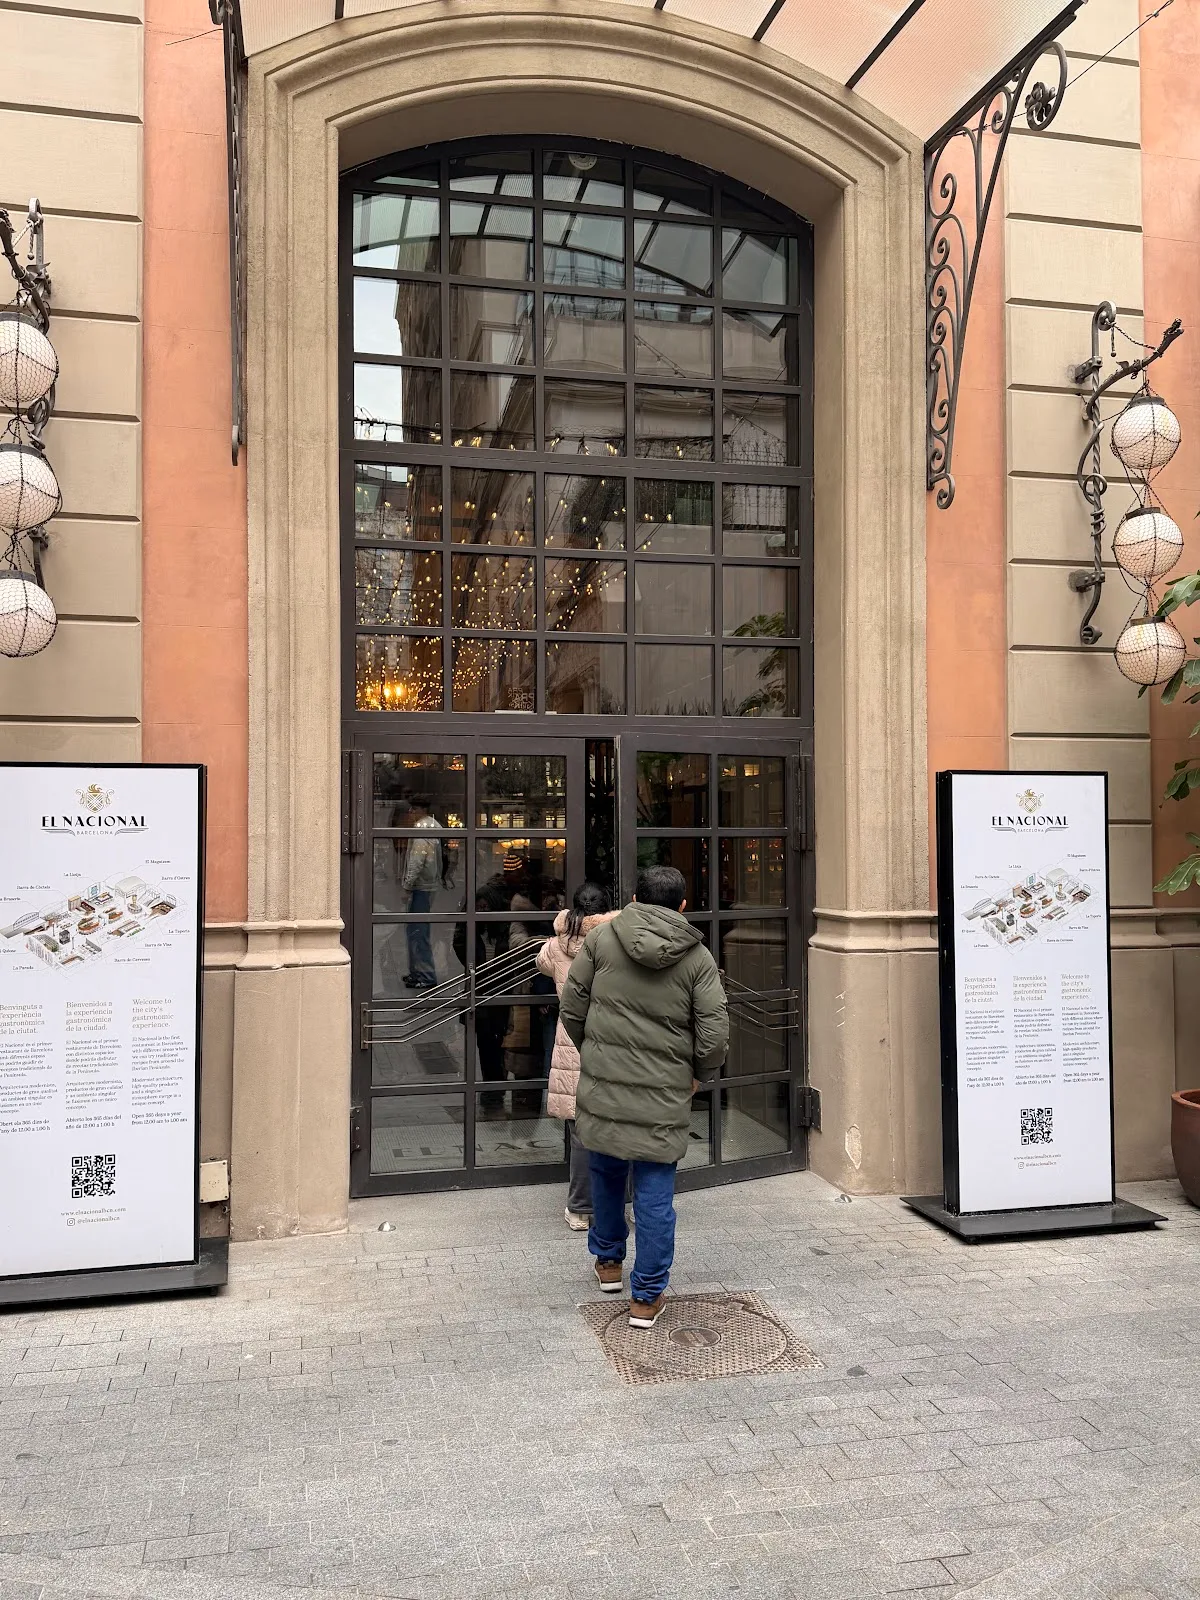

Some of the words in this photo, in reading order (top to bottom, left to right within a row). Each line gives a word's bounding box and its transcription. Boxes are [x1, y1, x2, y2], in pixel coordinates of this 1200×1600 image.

[42, 815, 58, 828] EL
[62, 815, 147, 827] NACIONAL
[992, 815, 1004, 826] EL
[1006, 815, 1069, 826] NACIONAL
[73, 1008, 113, 1016] experiencia
[145, 1006, 163, 1014] city's
[66, 1017, 112, 1025] gastronómica
[132, 1013, 174, 1022] gastronomic
[83, 1023, 107, 1031] ciudad.
[132, 1021, 171, 1030] experience.
[60, 1207, 127, 1216] www.elnacionalbcn.com
[77, 1215, 120, 1224] @elnacionalbcn
